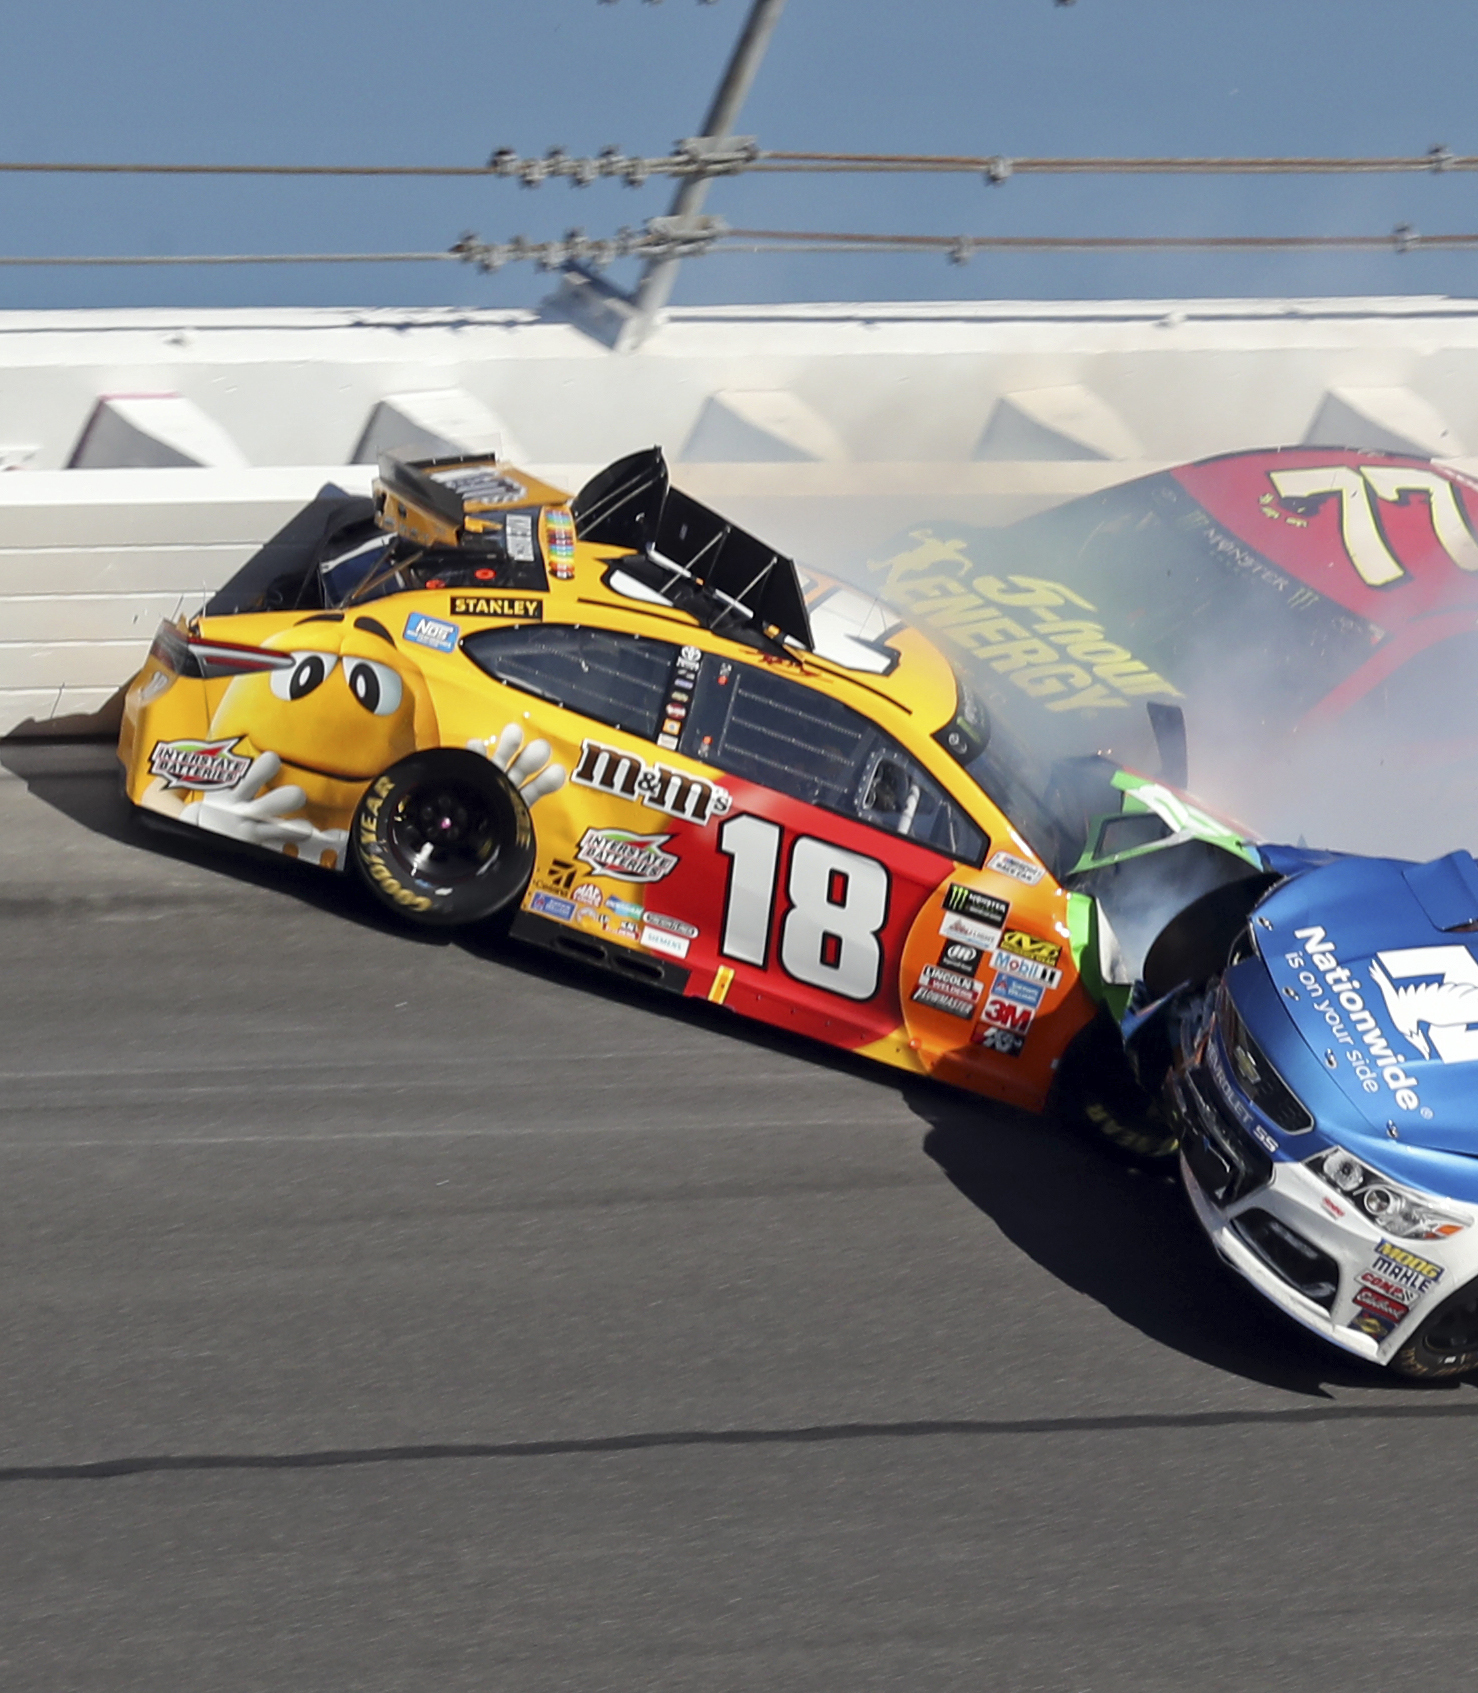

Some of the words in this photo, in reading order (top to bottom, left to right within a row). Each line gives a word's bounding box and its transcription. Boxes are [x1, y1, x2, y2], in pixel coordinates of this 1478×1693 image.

[455, 598, 538, 616] STANLEY
[896, 575, 1132, 712] ENERGY
[159, 745, 242, 772] INTERSTATE
[159, 760, 236, 782] BATTERIES
[586, 847, 660, 878] BATTERIES
[587, 834, 670, 869] INTERSTATE
[717, 812, 890, 1001] 18
[925, 965, 973, 991] LINCOLN
[995, 950, 1038, 977] Mobil
[912, 986, 974, 1014] FLOWMASTER
[985, 999, 1032, 1034] 3M
[1284, 951, 1304, 969] is
[1299, 970, 1324, 999] on
[1313, 999, 1356, 1046] your
[1346, 1049, 1380, 1094] side
[1294, 925, 1421, 1111] Nationwide
[1253, 1125, 1279, 1153] SS
[1380, 1243, 1438, 1279] MOOG
